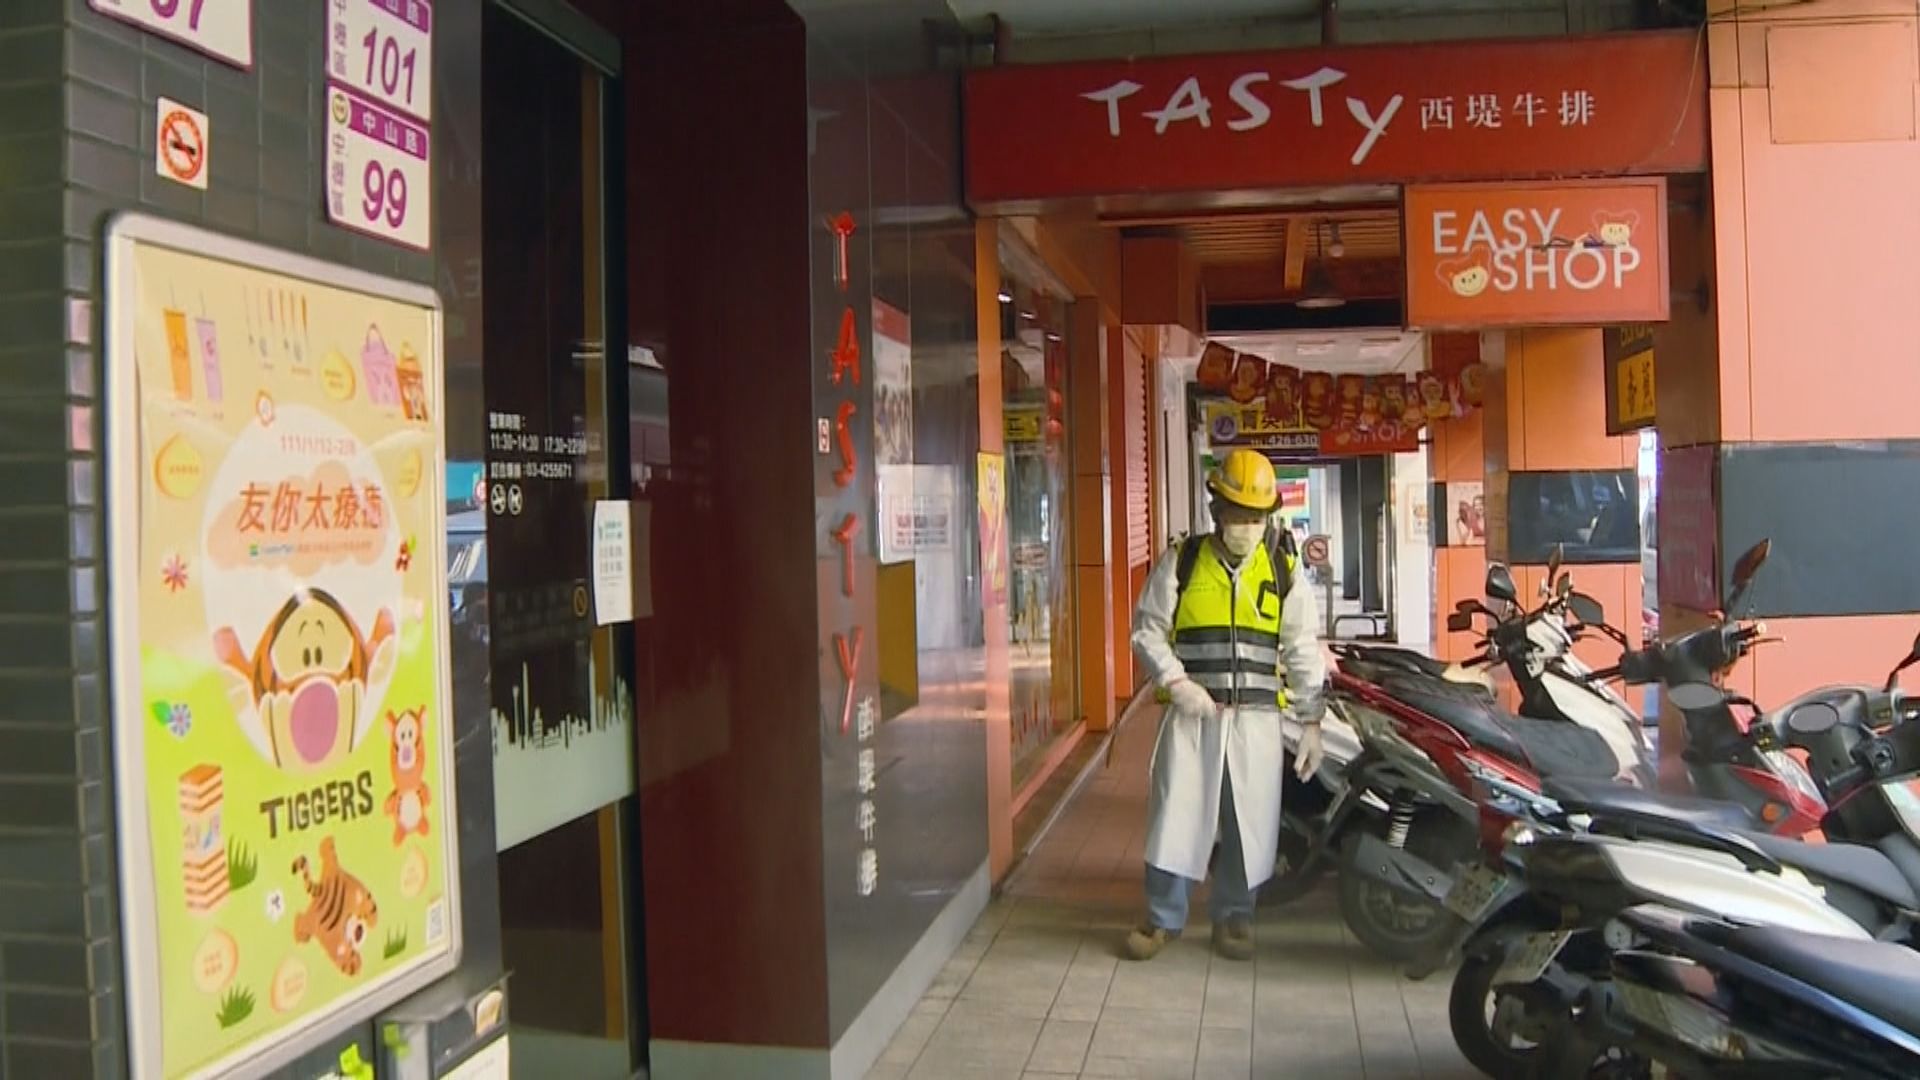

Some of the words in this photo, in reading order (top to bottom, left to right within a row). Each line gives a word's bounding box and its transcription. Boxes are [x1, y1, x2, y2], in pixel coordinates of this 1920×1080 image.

[363, 25, 416, 105] 101
[362, 110, 418, 155] 中山路
[1420, 90, 1597, 131] 西堤牛排
[362, 160, 407, 229] 99
[1432, 208, 1563, 255] EASY
[1493, 246, 1642, 292] SHOP
[259, 770, 374, 839] TIGGERS
